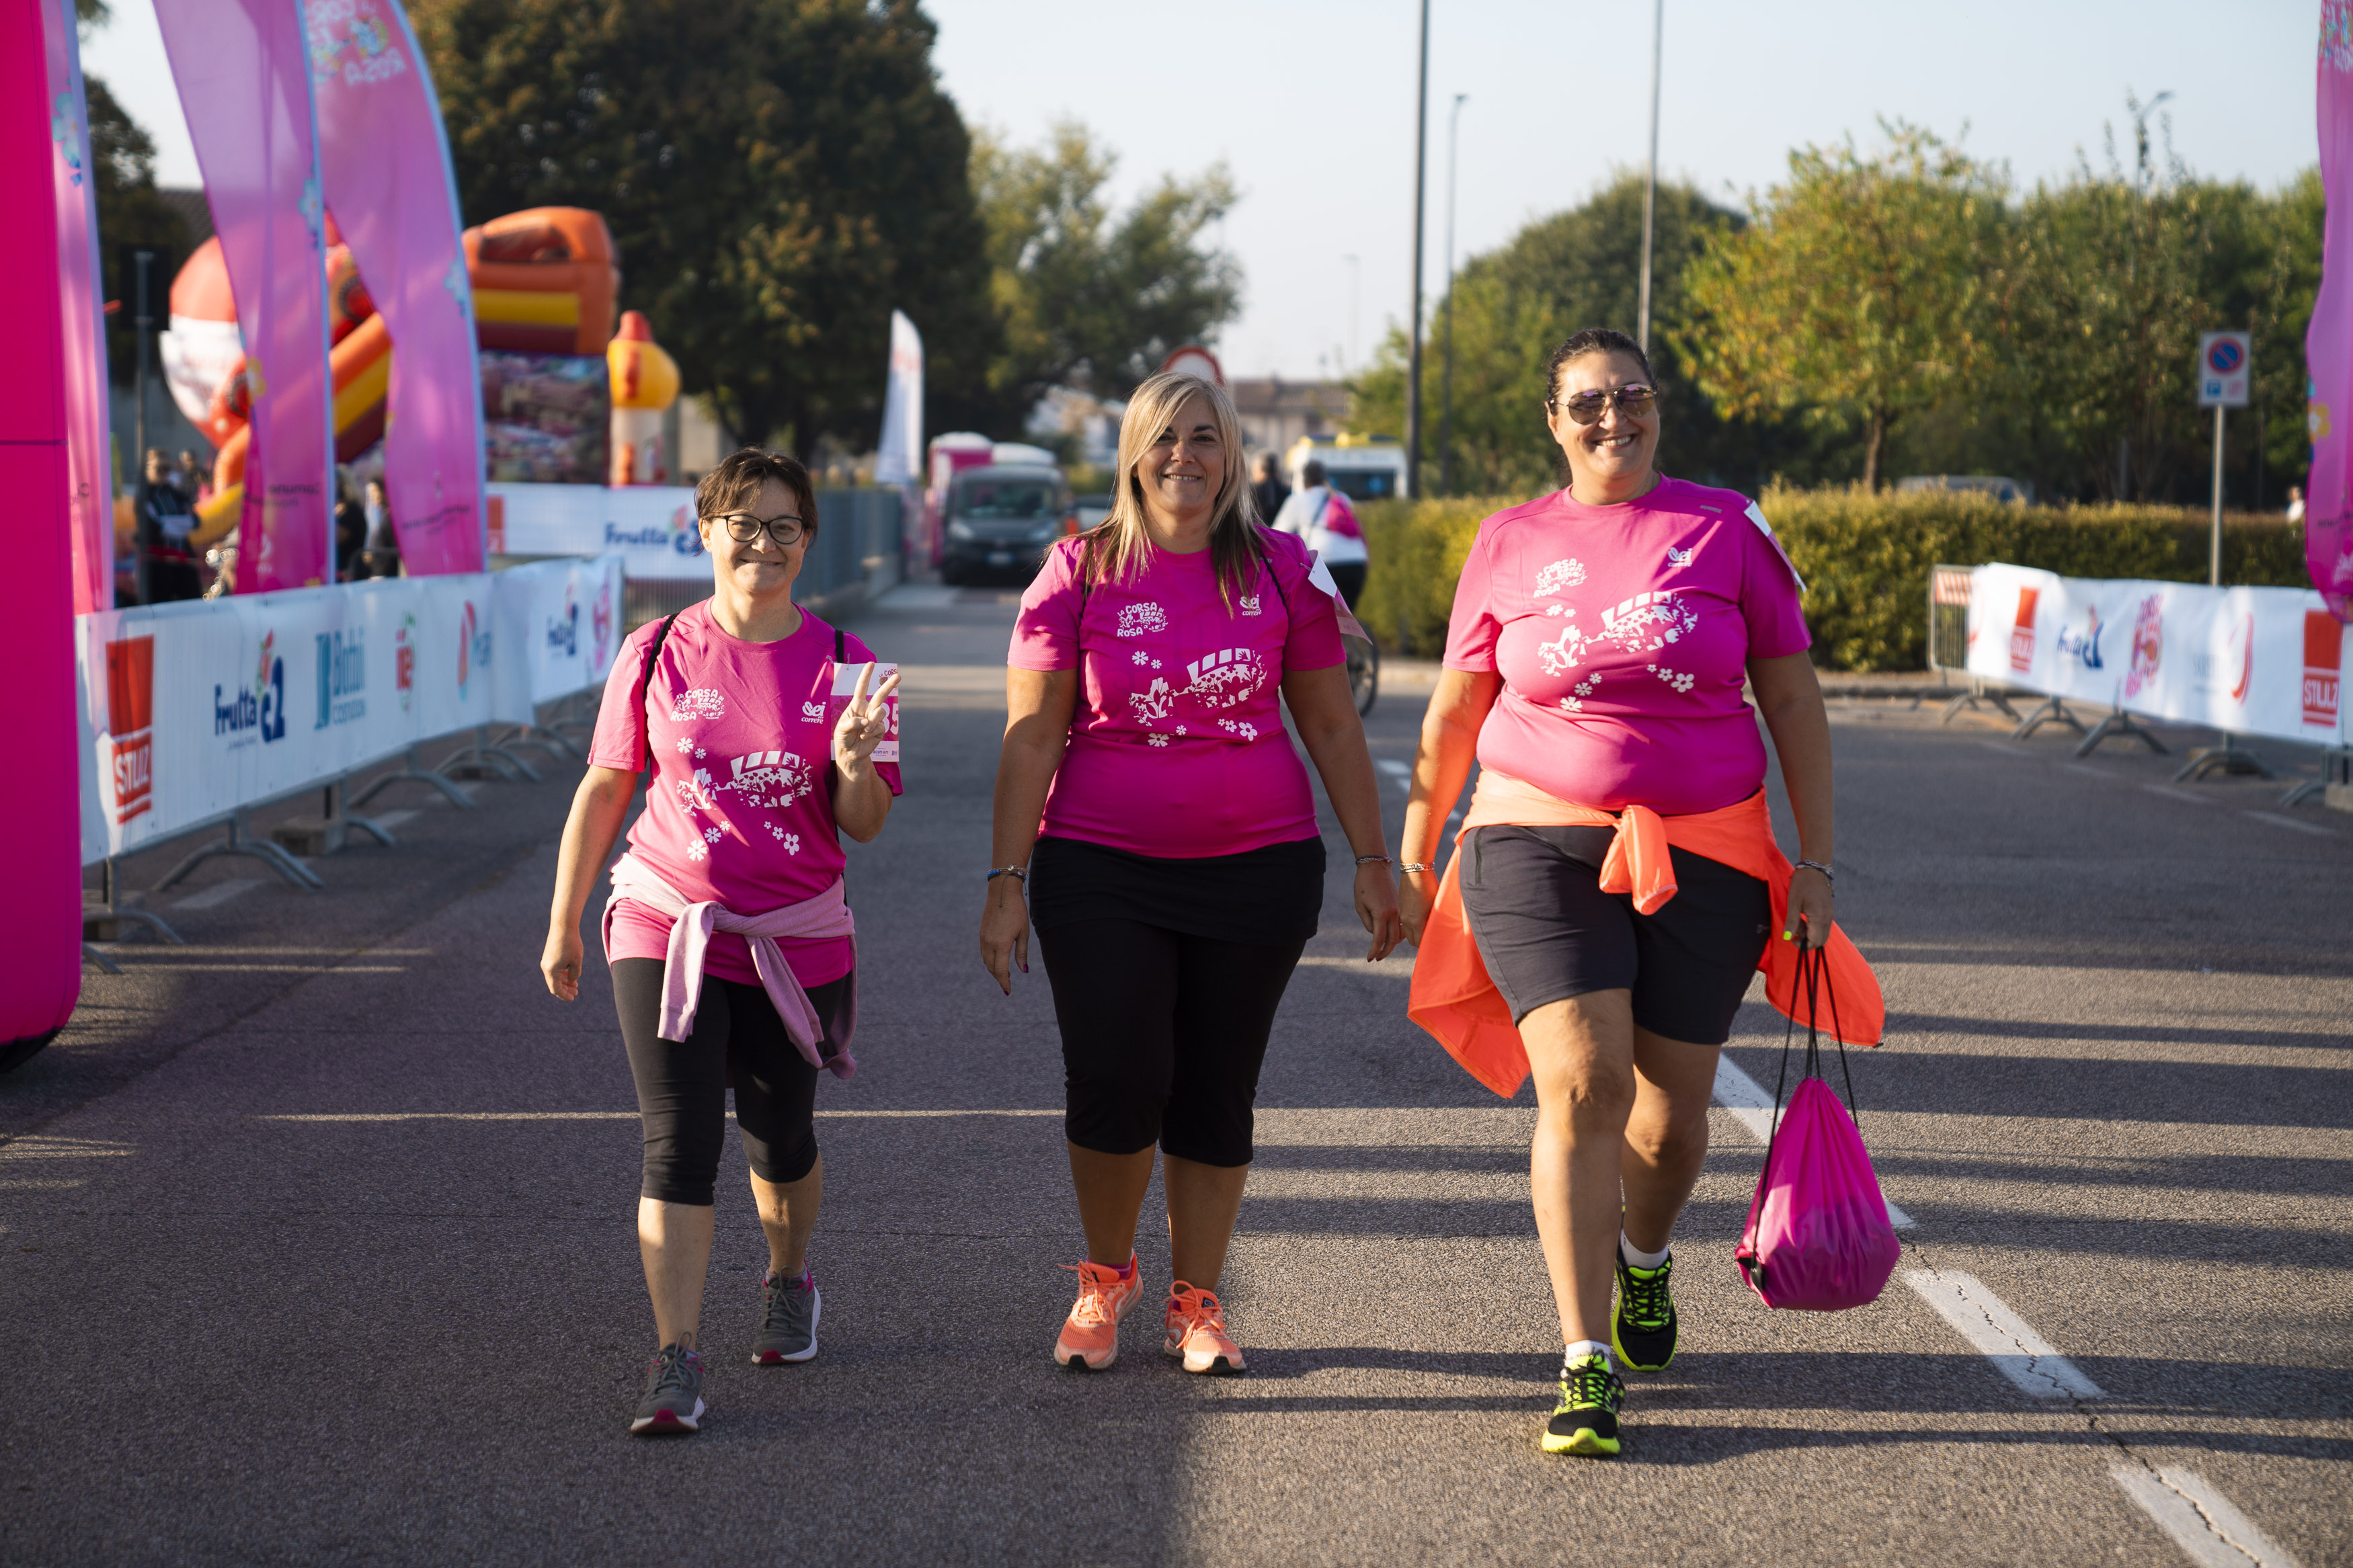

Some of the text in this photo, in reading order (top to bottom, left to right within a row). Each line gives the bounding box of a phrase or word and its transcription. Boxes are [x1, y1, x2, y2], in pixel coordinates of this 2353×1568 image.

[1543, 558, 1577, 575] CORSA
[1533, 583, 1561, 598] ROSA
[1125, 602, 1158, 614] CORSA
[1117, 626, 1144, 637] ROSA
[884, 668, 898, 676] CORS
[686, 688, 719, 699] CORSA
[2305, 679, 2339, 709] STULZ
[214, 684, 257, 736] Frutta
[670, 710, 697, 722] ROSA
